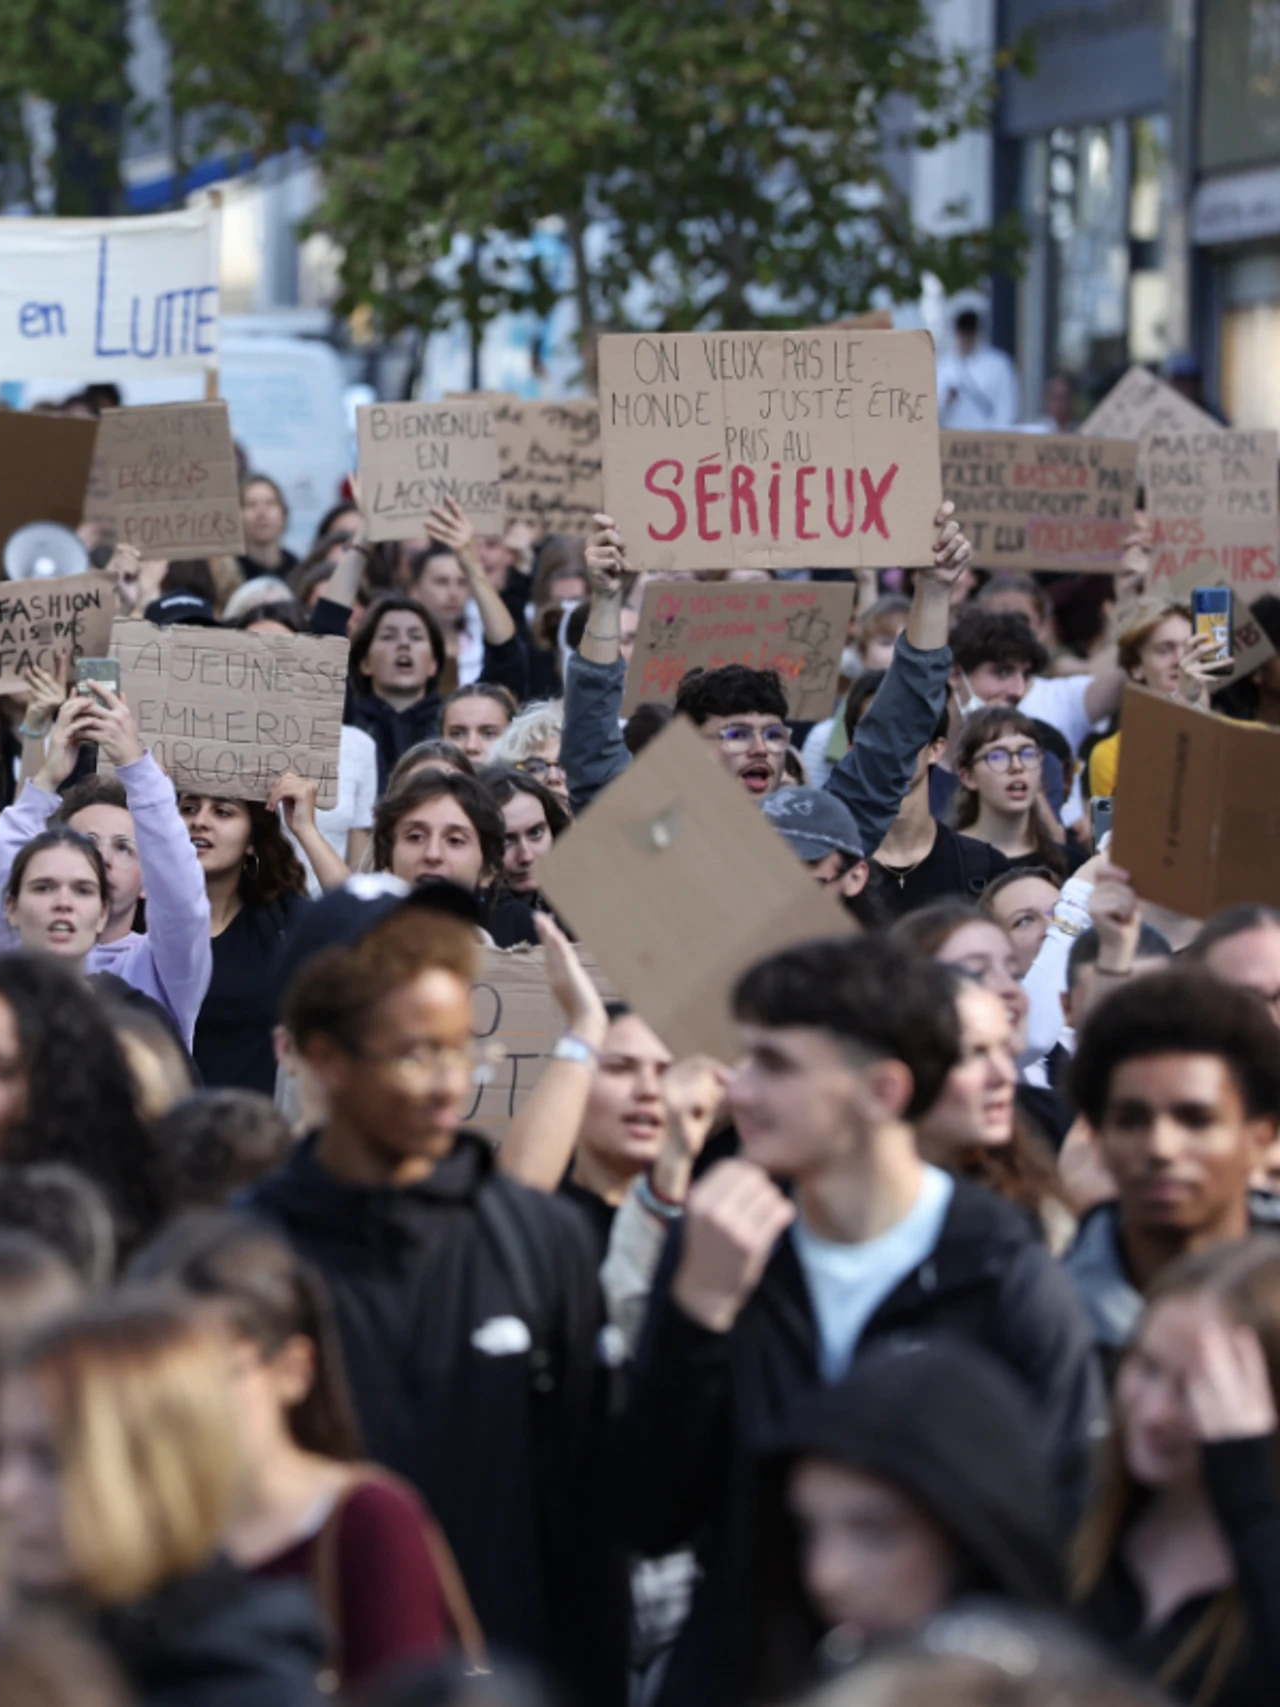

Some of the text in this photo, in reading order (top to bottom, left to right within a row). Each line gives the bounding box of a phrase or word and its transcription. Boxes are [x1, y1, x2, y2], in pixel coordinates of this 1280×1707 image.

[19, 301, 66, 338] en
[94, 236, 218, 358] LUTTE
[633, 338, 864, 384] ON VEUX PAS LE
[371, 407, 497, 441] BIENVENUE
[611, 390, 712, 428] MONDE
[757, 387, 854, 421] JUSTE
[866, 381, 929, 423] ÊTRE
[416, 442, 450, 470] EN
[724, 426, 812, 463] PRIS AU
[643, 451, 899, 542] SÉRIEUX
[124, 509, 238, 544] POMPIERS
[53, 617, 85, 638] PAS
[171, 645, 346, 694] JEUNESSE
[138, 700, 340, 750] EMMERDE
